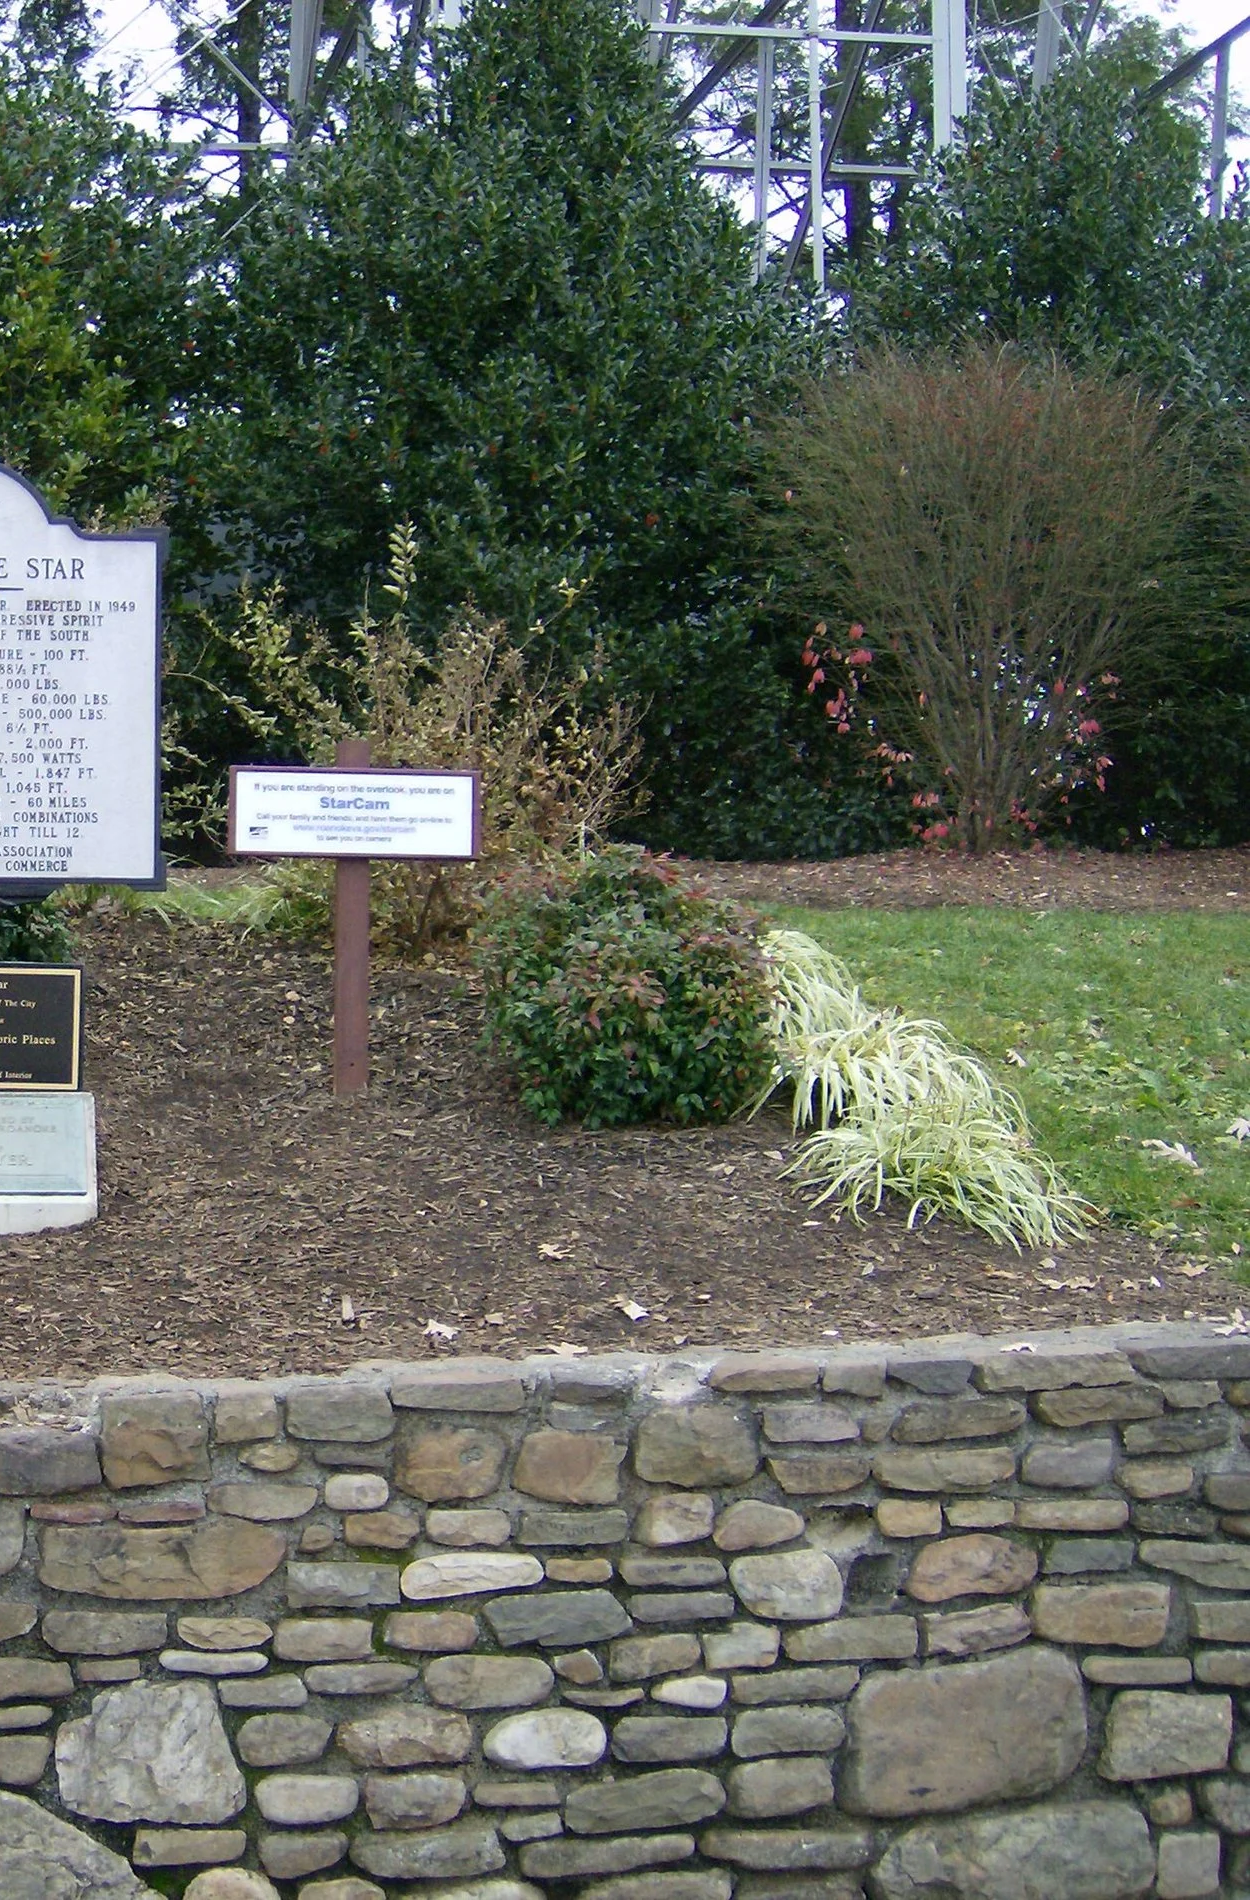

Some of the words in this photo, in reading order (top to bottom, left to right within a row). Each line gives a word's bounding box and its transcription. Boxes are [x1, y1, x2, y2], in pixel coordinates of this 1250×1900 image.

[26, 558, 84, 580] STAR
[26, 600, 82, 613] ERECTED
[89, 601, 101, 613] IN
[108, 601, 136, 613] 1949
[63, 615, 104, 627] SPIRIT
[16, 629, 42, 642] THE
[43, 649, 63, 661] 100
[70, 649, 89, 661] FT.
[32, 664, 51, 676] FT.
[33, 723, 53, 735] FT.
[69, 737, 89, 750] FT.
[41, 752, 82, 765] WATTS
[78, 767, 97, 779] FT.
[49, 782, 67, 794] FT.
[27, 796, 43, 809] 60
[48, 796, 87, 809] MILES
[320, 797, 389, 810] StarCam
[12, 811, 99, 824] COMBINATIONS
[29, 826, 57, 838] TILL
[5, 859, 69, 872] COMMERCE
[21, 1034, 56, 1046] Places
